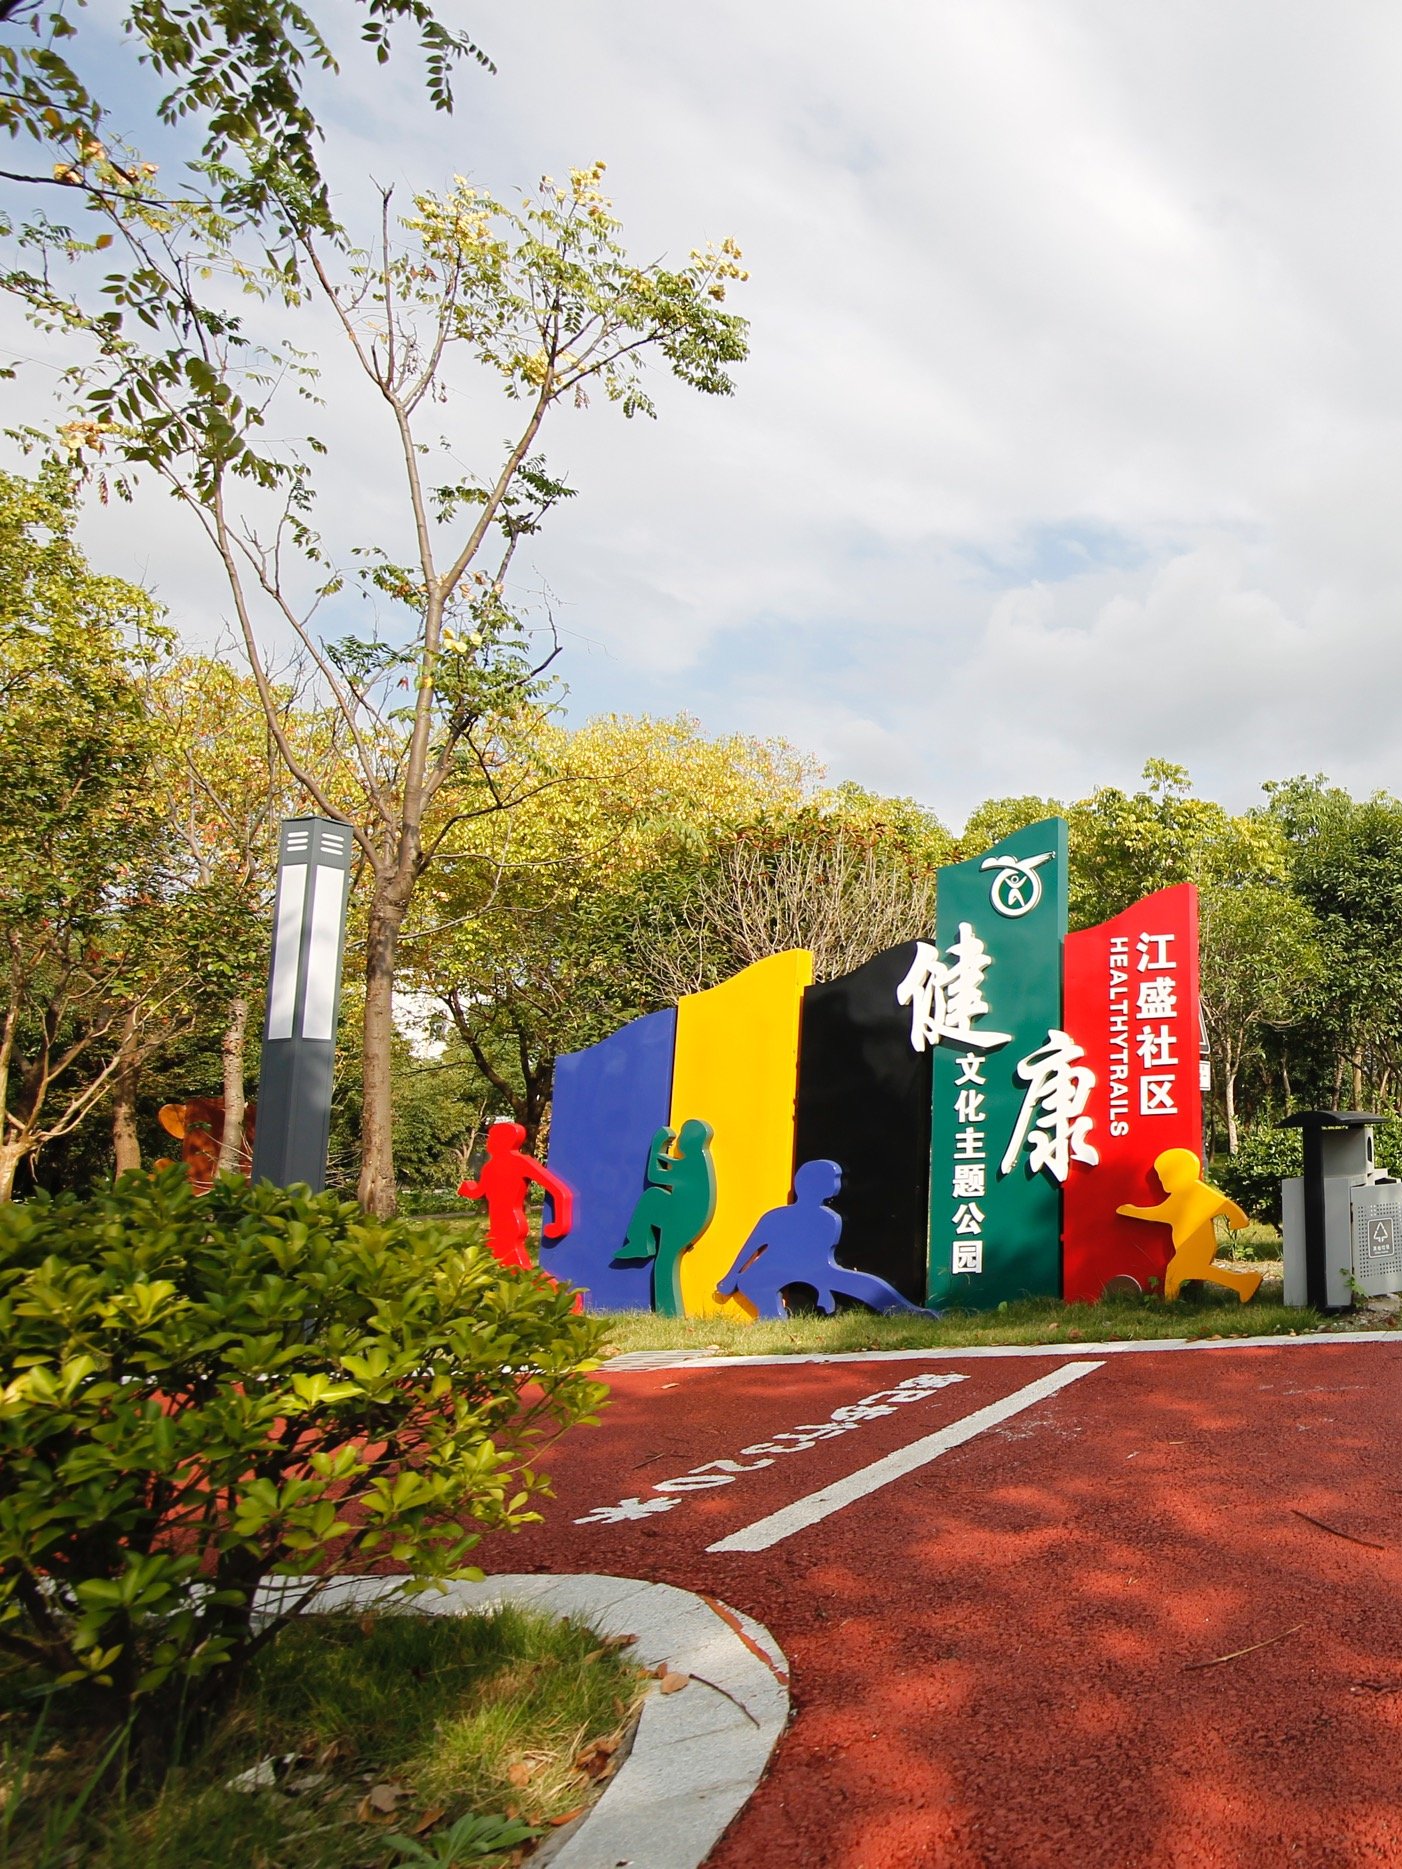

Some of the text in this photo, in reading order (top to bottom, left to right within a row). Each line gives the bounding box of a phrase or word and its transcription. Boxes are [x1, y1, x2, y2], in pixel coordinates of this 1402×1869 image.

[897, 922, 1100, 1182] 健康
[1135, 931, 1179, 1116] 江盛社区
[951, 1052, 986, 1275] 文化主题公园
